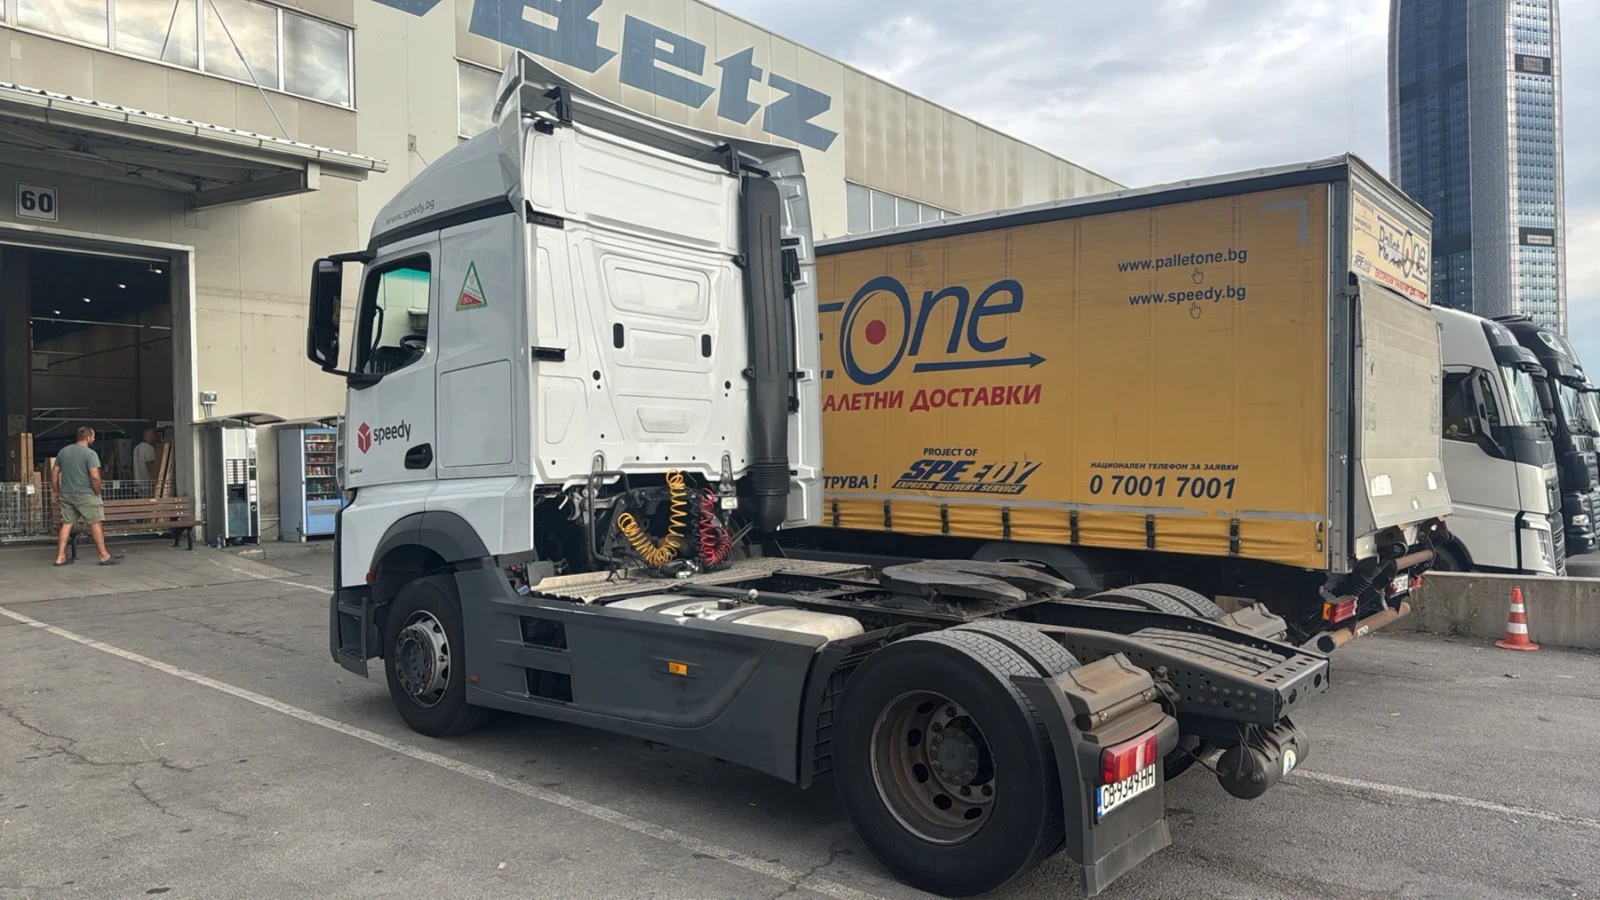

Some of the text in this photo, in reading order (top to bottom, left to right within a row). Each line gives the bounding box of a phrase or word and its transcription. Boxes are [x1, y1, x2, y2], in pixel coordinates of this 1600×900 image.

[21, 190, 53, 213] 60
[385, 200, 435, 226] www.speedy.bg
[1118, 248, 1247, 272] www.palletone.bg
[1129, 285, 1246, 305] www.speedy.bg
[909, 384, 1042, 412] ДОСТАВКИ
[373, 419, 411, 446] speedy
[923, 448, 978, 457] PROJECT OF
[1090, 462, 1146, 470] НАЦИОНАЛЕН
[1190, 463, 1201, 471] ЗА
[896, 481, 1021, 493] EXPRESS DELIVERY SERVICE
[1089, 474, 1236, 499] 0 7001 7001
